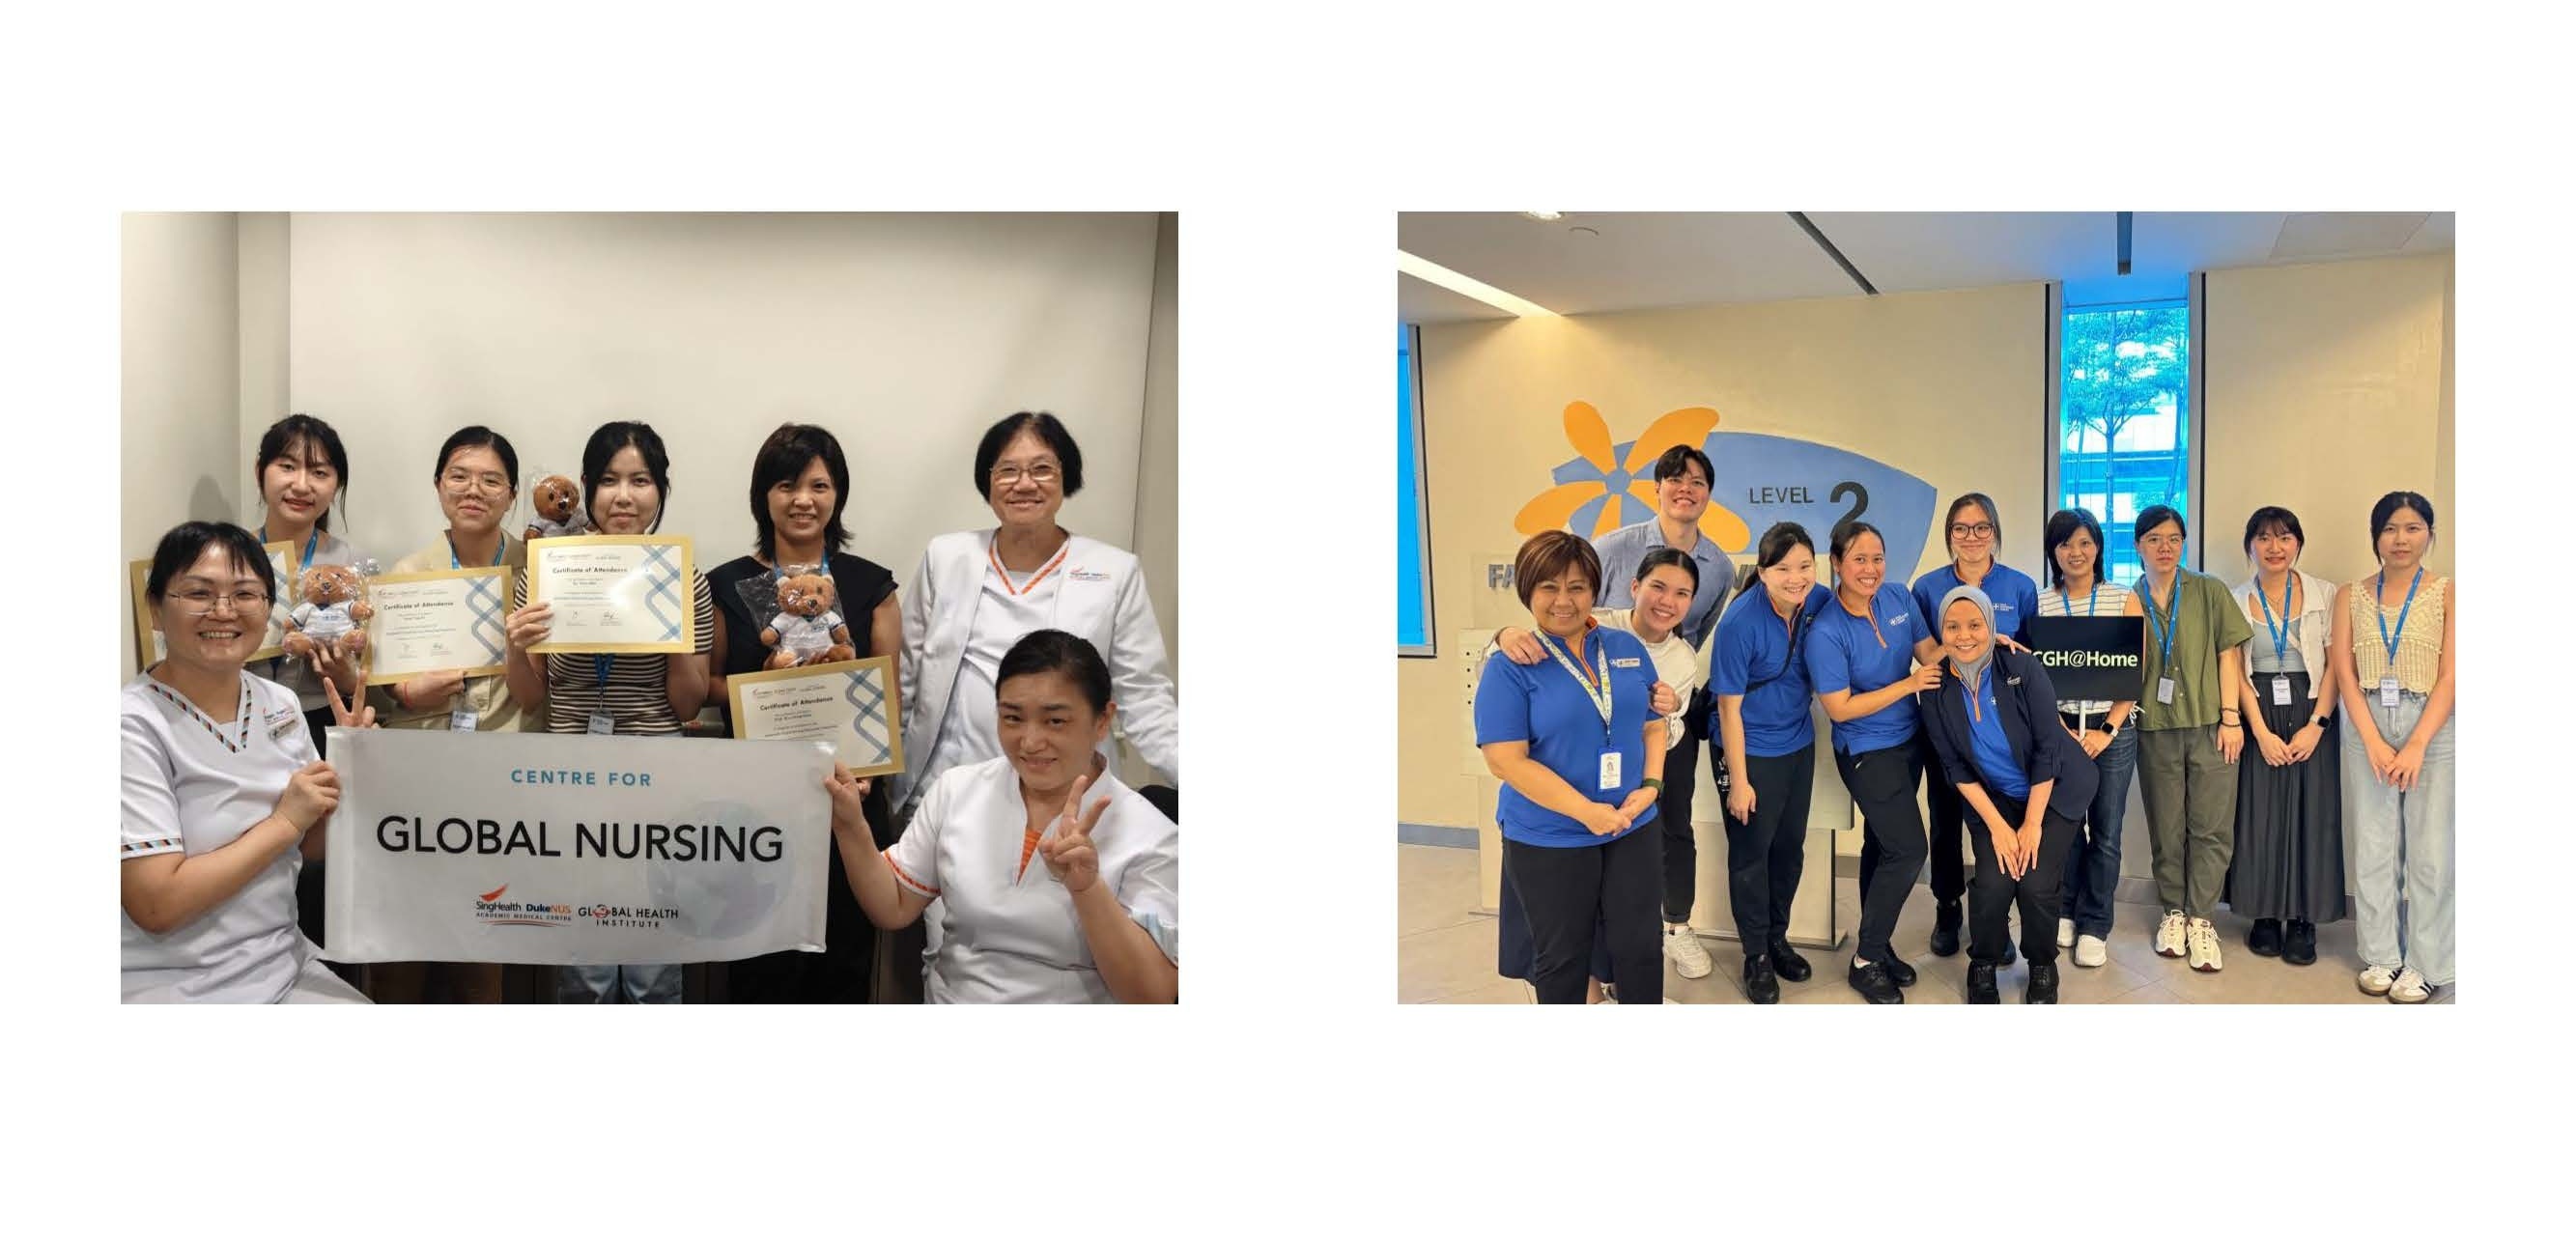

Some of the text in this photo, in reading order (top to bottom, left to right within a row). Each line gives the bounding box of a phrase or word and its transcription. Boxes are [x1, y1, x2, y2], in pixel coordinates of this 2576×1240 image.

[1749, 482, 1869, 539] LEVEL 2
[801, 696, 834, 705] Attendance
[511, 769, 651, 786] CENTRE FOR
[377, 816, 783, 862] GLOBAL NURSING
[476, 901, 522, 913] SingHealth
[579, 904, 679, 919] GLOBAL HEALTH
[596, 919, 661, 928] INSTITUTE
